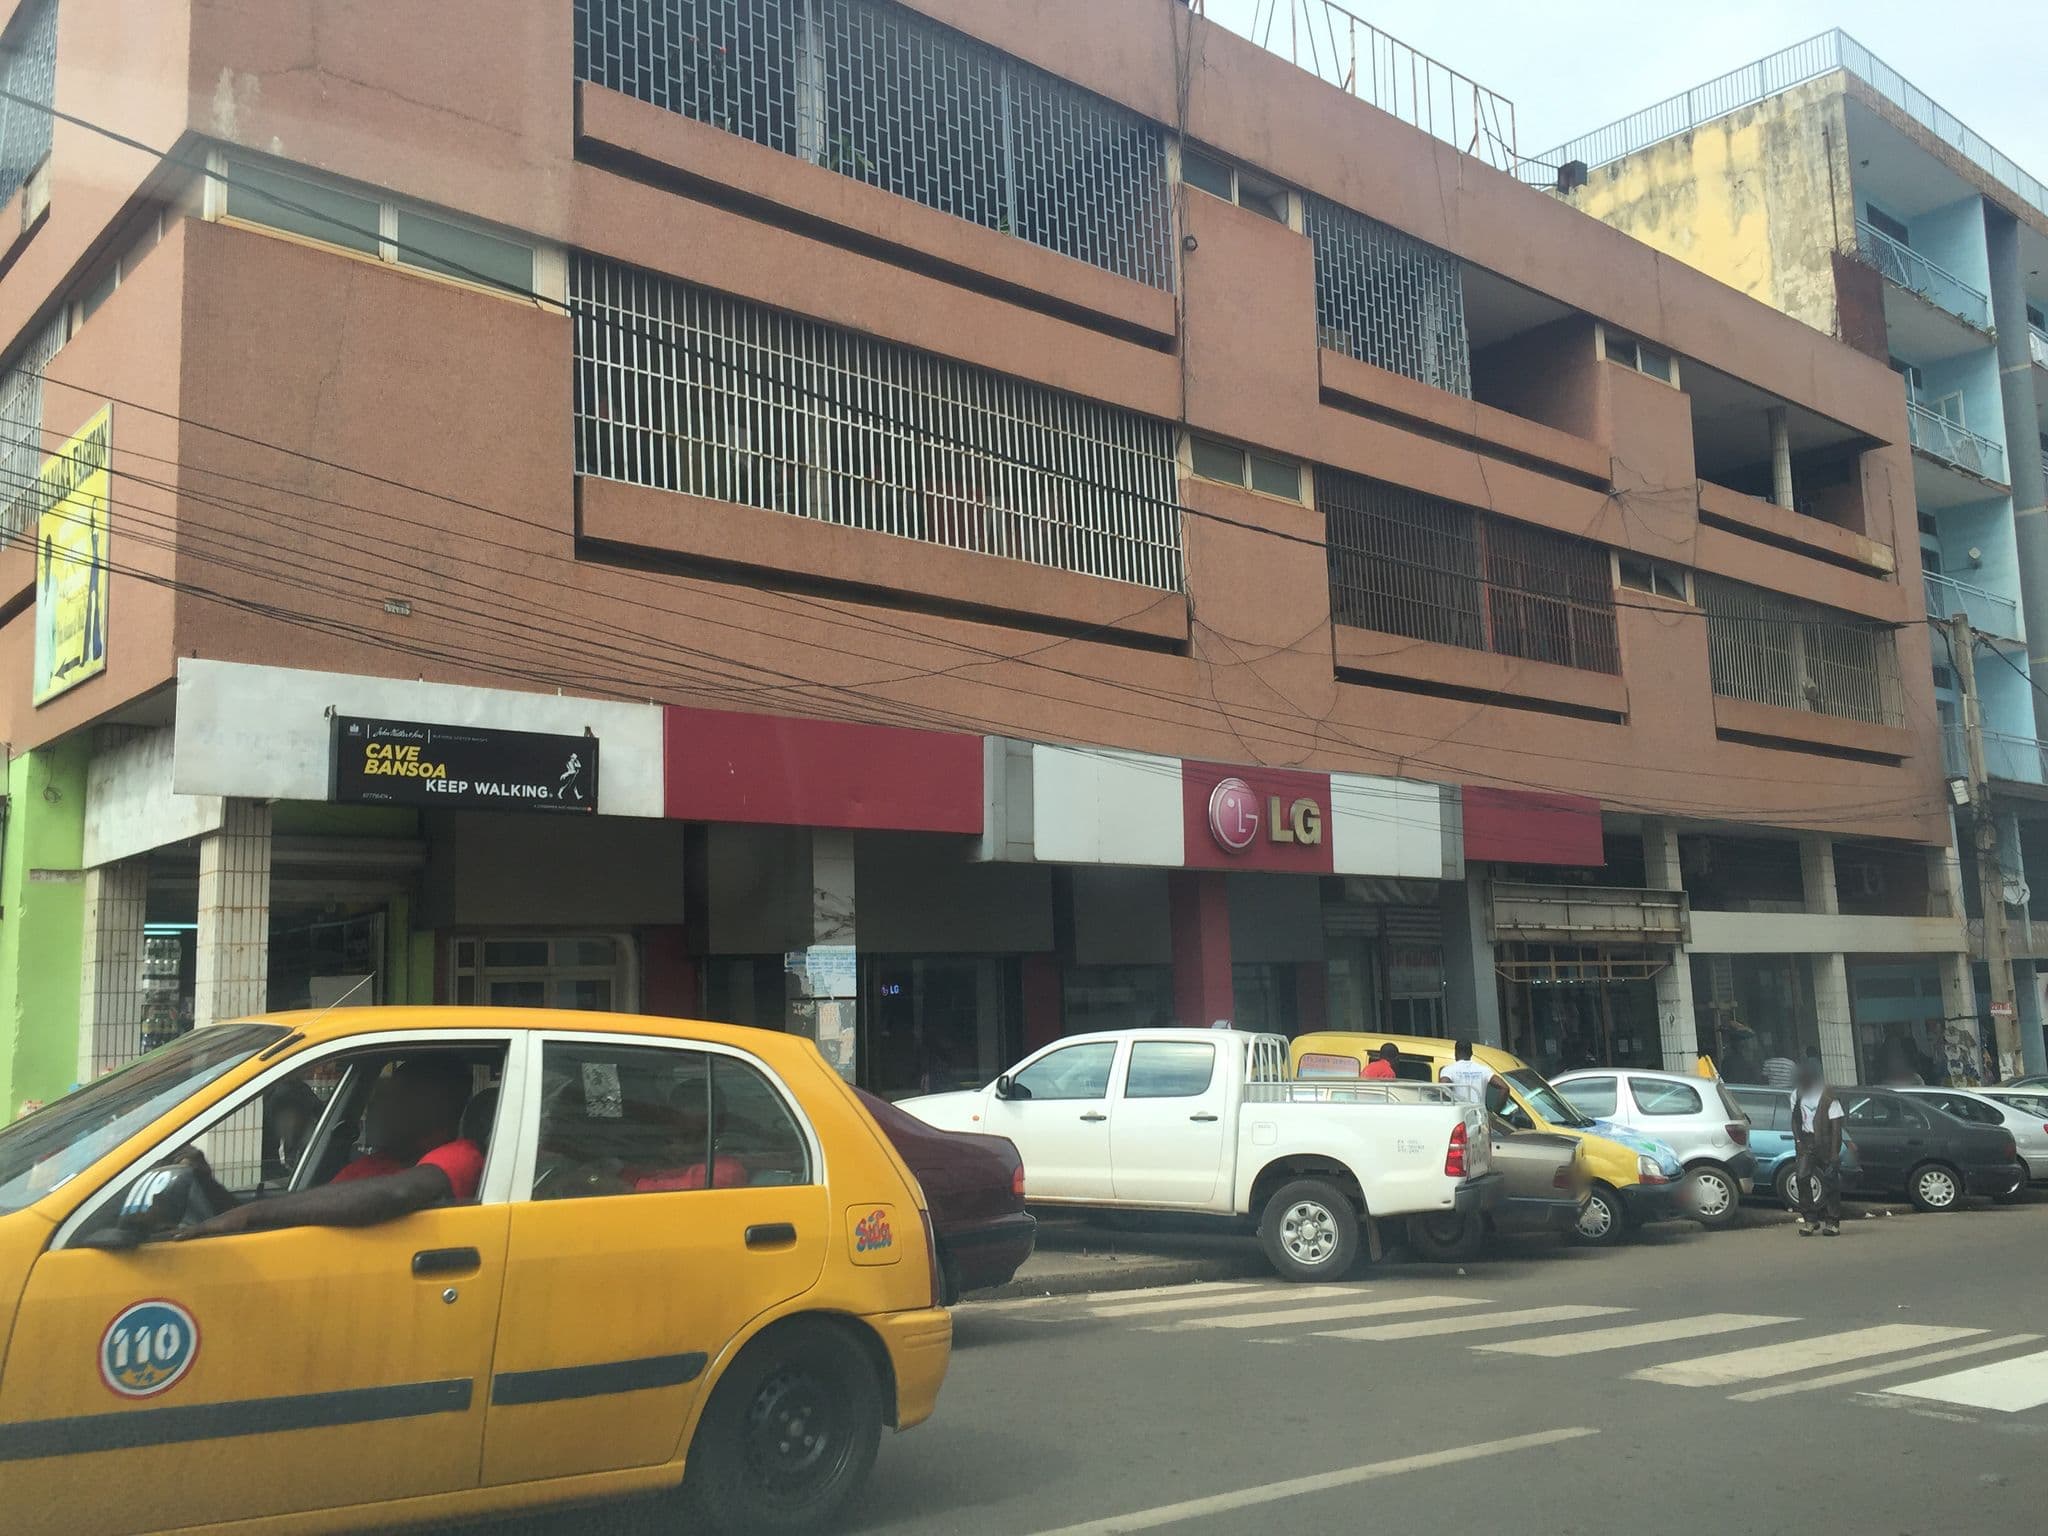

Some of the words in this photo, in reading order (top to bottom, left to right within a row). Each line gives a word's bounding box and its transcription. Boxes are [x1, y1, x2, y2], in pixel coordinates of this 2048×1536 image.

[366, 743, 420, 760] CAVE
[364, 760, 446, 778] BANSOA
[425, 779, 469, 793] KEEP
[1268, 796, 1322, 845] LG
[113, 1323, 180, 1368] 110
